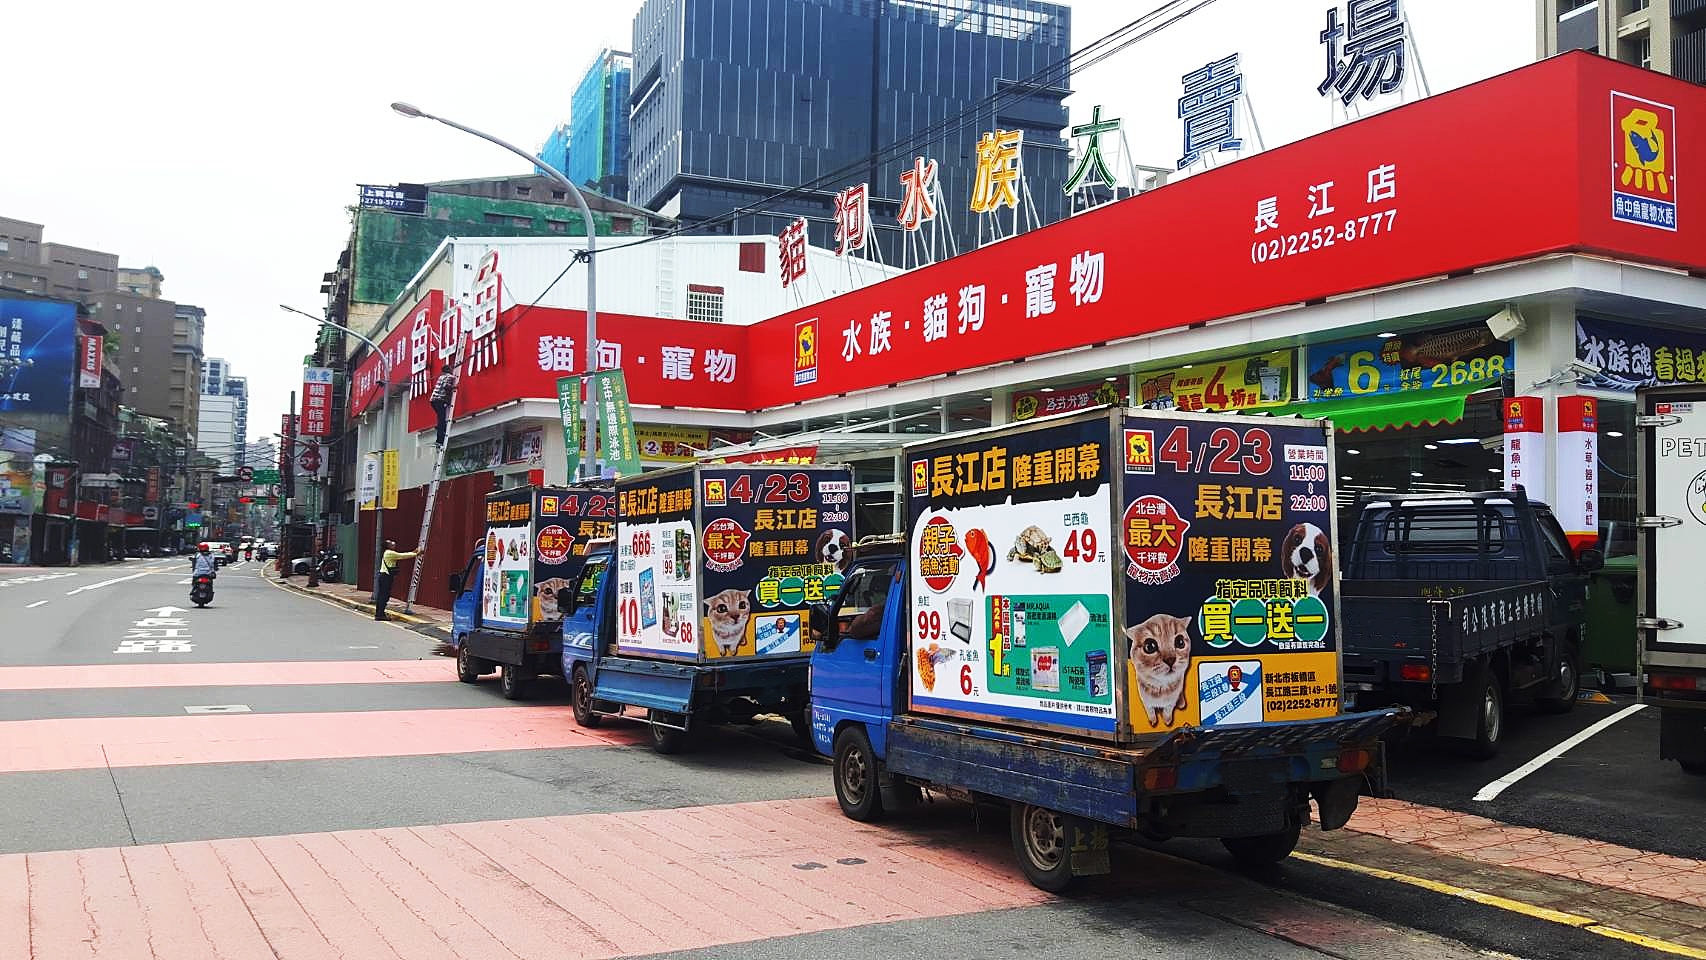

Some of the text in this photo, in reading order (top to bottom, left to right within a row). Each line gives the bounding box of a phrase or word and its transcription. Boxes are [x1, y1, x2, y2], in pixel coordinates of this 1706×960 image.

[1254, 164, 1396, 234] 長江店
[1615, 197, 1674, 225] 魚中魚寵物水族
[1251, 209, 1397, 264] (02)2252-8777
[1348, 351, 1381, 394] 6
[1431, 354, 1505, 388] 2688
[1159, 426, 1273, 476] 4/23
[1287, 449, 1325, 461] 營業時間
[931, 442, 1101, 498] 長江店 隆重開幕
[1289, 465, 1326, 481] 11:00
[628, 486, 658, 517] 長江店
[729, 473, 811, 504] 4/23
[1194, 484, 1284, 521] 長江店
[1290, 495, 1327, 511] 22:00
[754, 508, 818, 531] 長江店
[1136, 502, 1167, 516] 北台灣
[540, 535, 567, 549] 最大
[632, 531, 651, 557] 666
[707, 532, 742, 550] 最大
[922, 525, 957, 555] 親子
[1063, 528, 1106, 564] 49 元
[1127, 518, 1177, 547] 最大
[749, 539, 809, 558] 隆重開幕
[1137, 551, 1169, 564] 千坪數
[1188, 536, 1272, 562] 隆重開幕
[759, 578, 841, 604] 買一送一
[620, 597, 639, 637] 10
[917, 610, 941, 640] 99
[1203, 602, 1324, 641] 買一送一
[681, 621, 693, 644] 68
[960, 664, 973, 696] 6
[1266, 697, 1337, 713] (02)2252-8777
